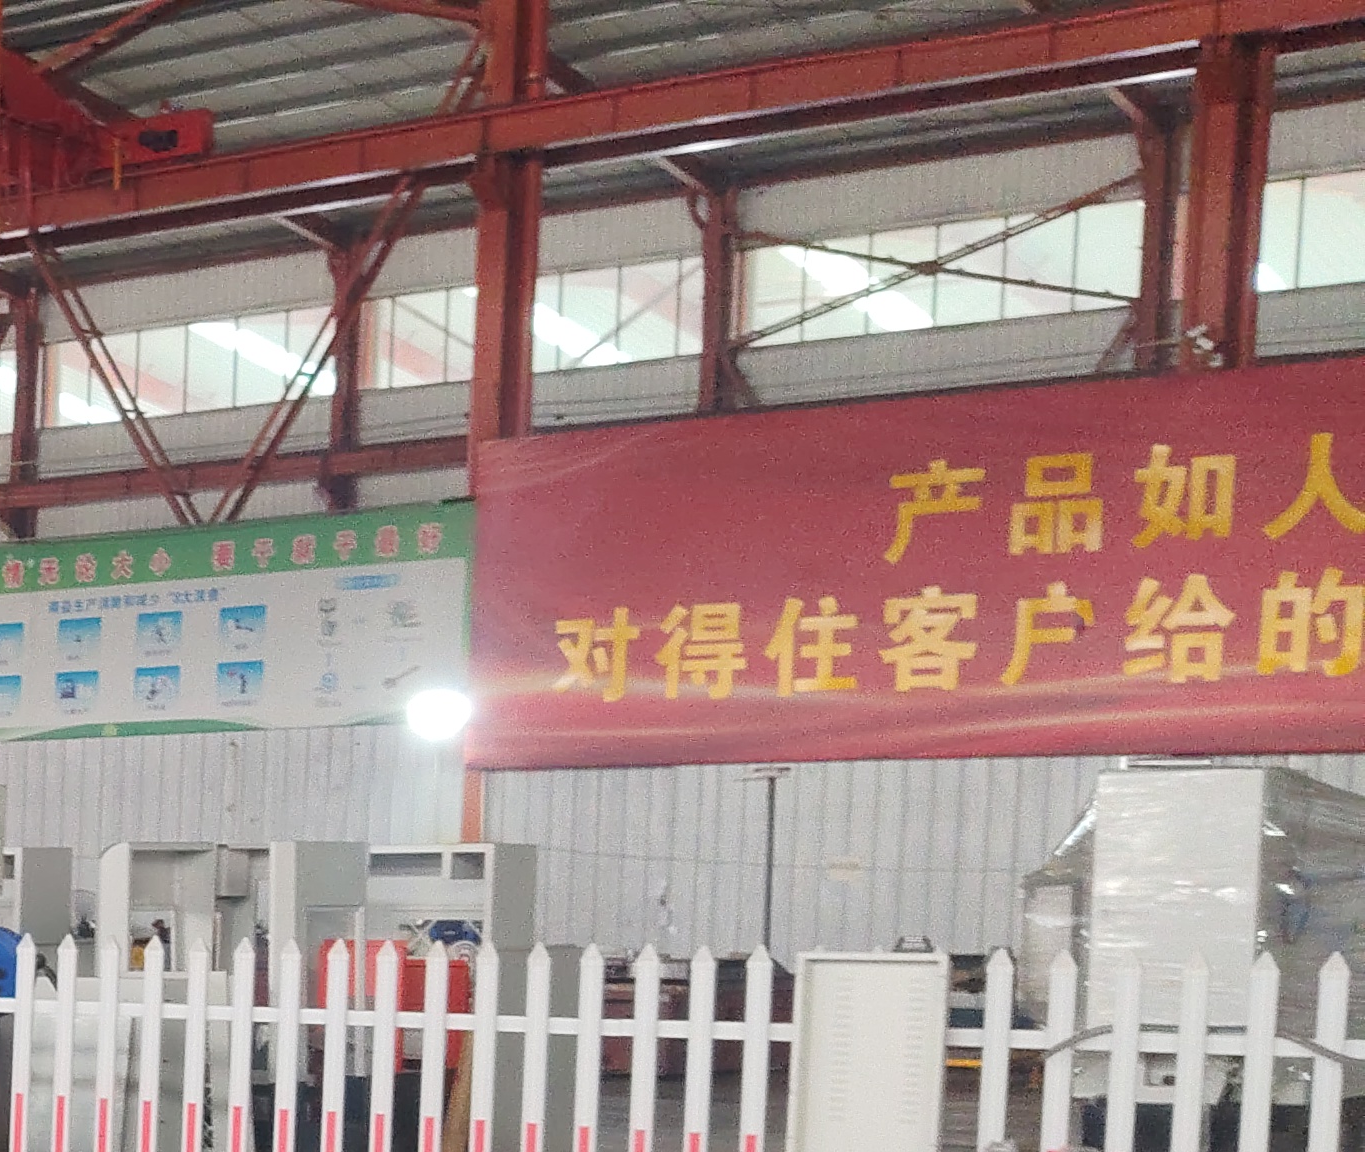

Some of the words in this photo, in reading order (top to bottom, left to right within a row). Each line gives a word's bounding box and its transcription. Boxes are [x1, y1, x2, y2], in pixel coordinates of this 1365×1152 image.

[884, 432, 1365, 564] 产品如人
[555, 567, 1365, 702] 对得住客户给的
